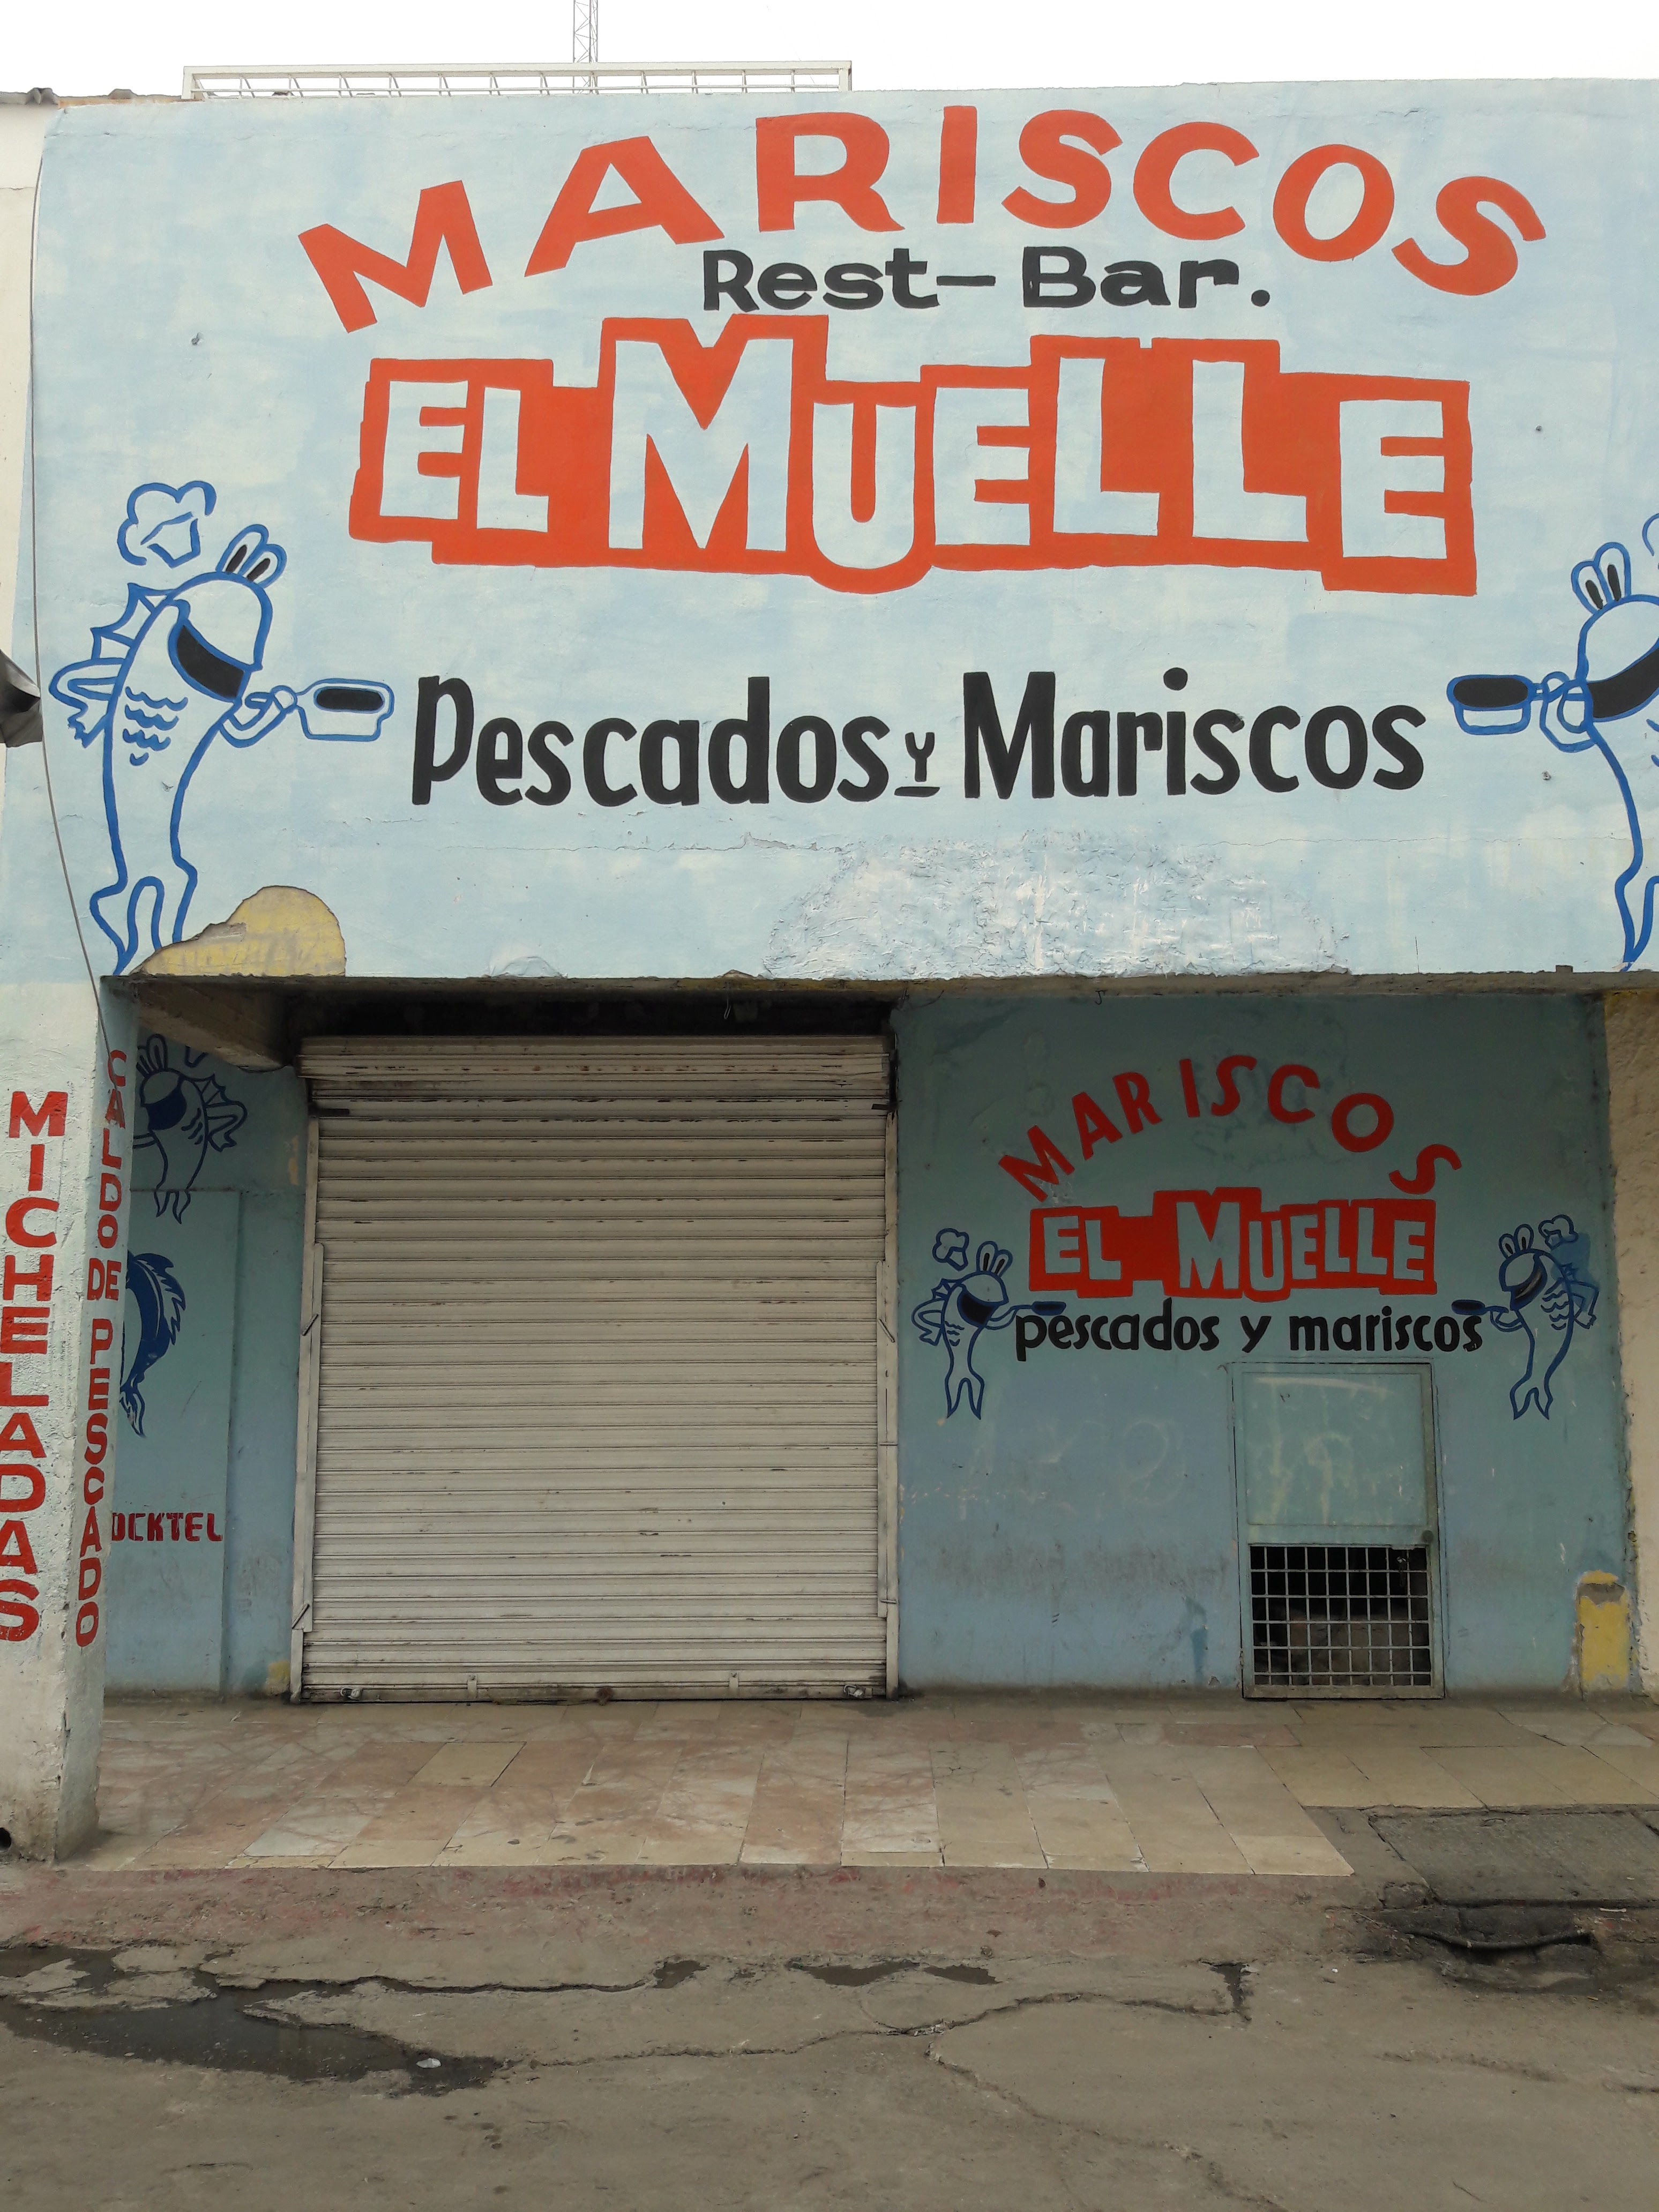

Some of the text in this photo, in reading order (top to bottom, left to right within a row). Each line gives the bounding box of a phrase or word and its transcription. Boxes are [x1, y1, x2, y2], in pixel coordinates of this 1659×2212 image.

[298, 105, 1546, 333] MARISCOS
[376, 334, 1448, 569] EL MUELLE
[412, 675, 890, 807] Pescados
[963, 667, 1427, 799] Mariscos
[998, 1055, 1462, 1202] MARISCOS
[1015, 1297, 1483, 1362] pescados y mariscos
[1040, 1199, 1429, 1292] EL MUELLE
[0, 1090, 68, 1642] MICHELADAS
[76, 1049, 128, 1647] CALDO DE PESCADO
